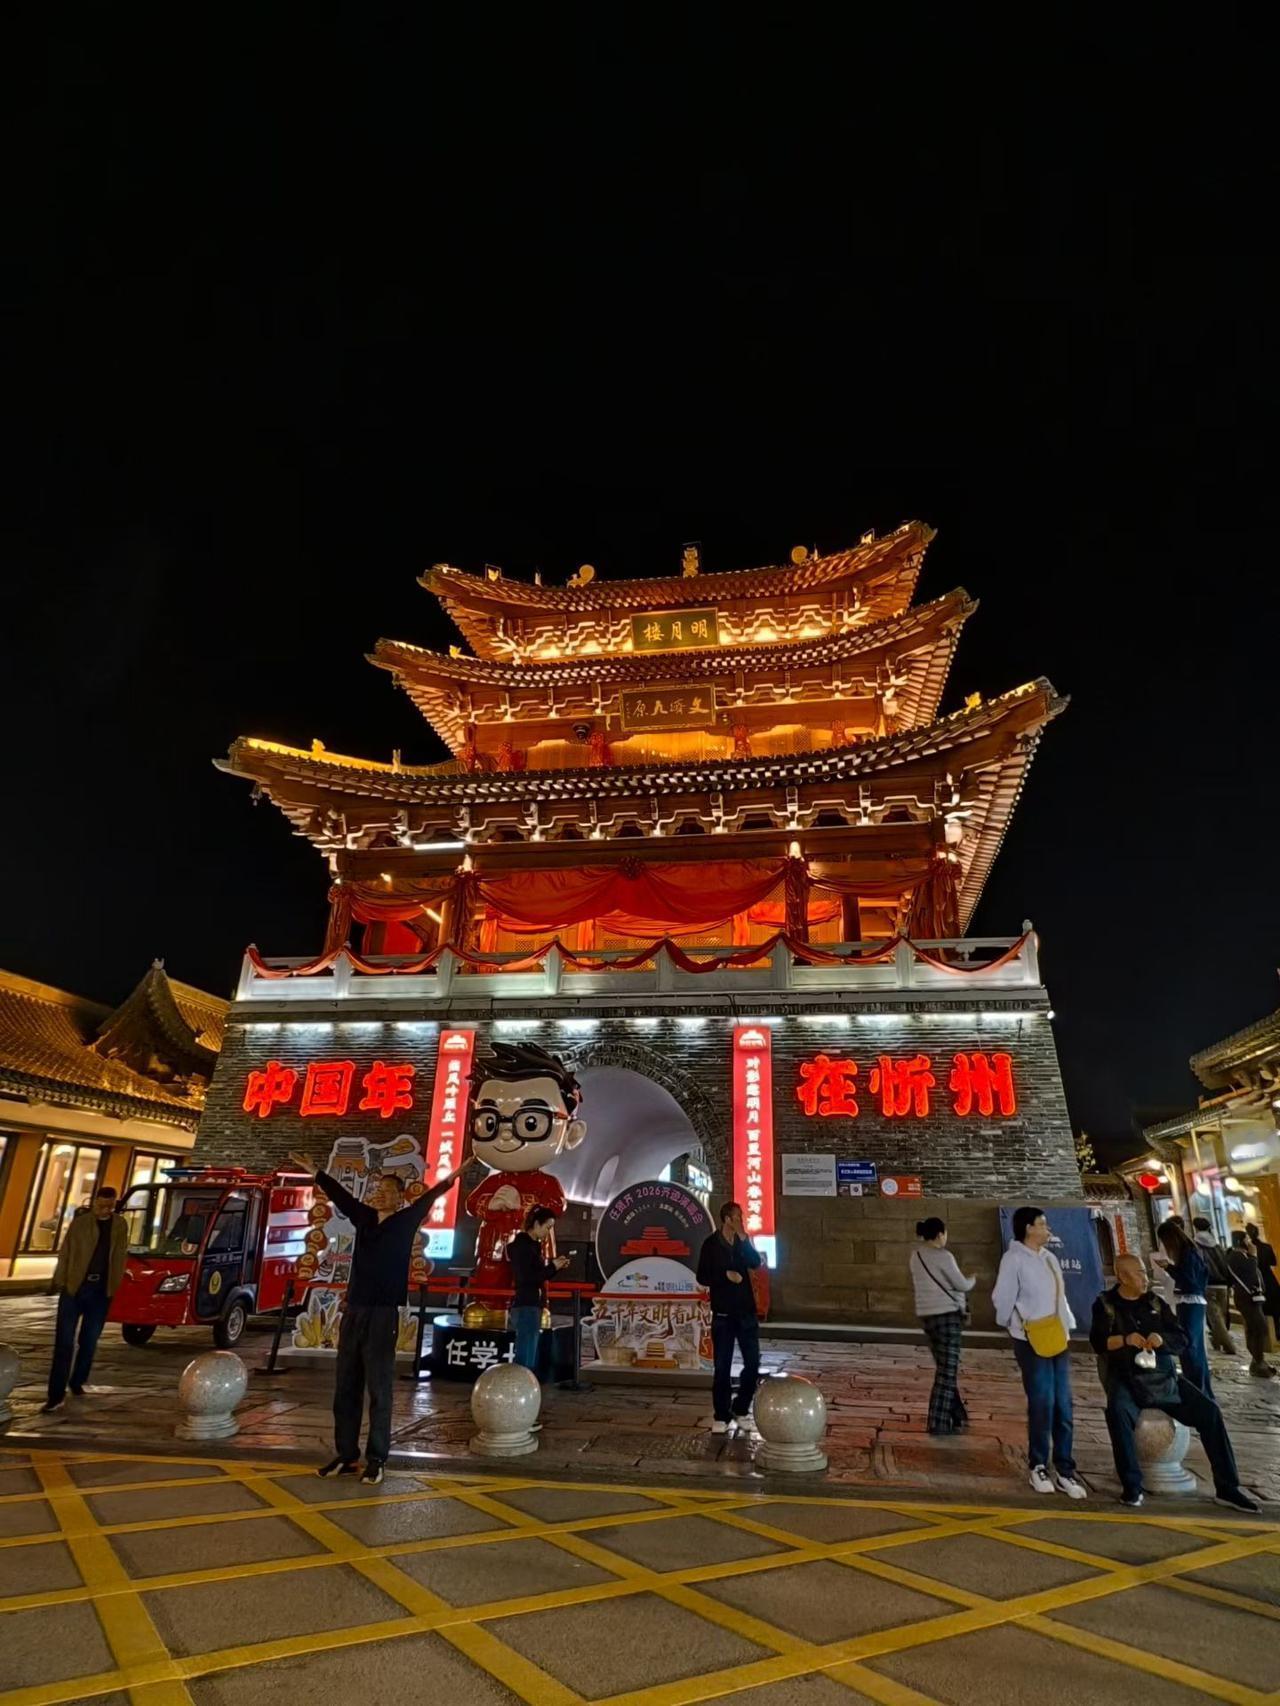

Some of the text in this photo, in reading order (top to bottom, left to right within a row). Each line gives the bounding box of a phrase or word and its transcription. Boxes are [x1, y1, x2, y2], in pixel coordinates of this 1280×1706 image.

[643, 619, 708, 641] 明月楼
[243, 1060, 416, 1118] 中国年
[797, 1053, 1016, 1117] 在忻州
